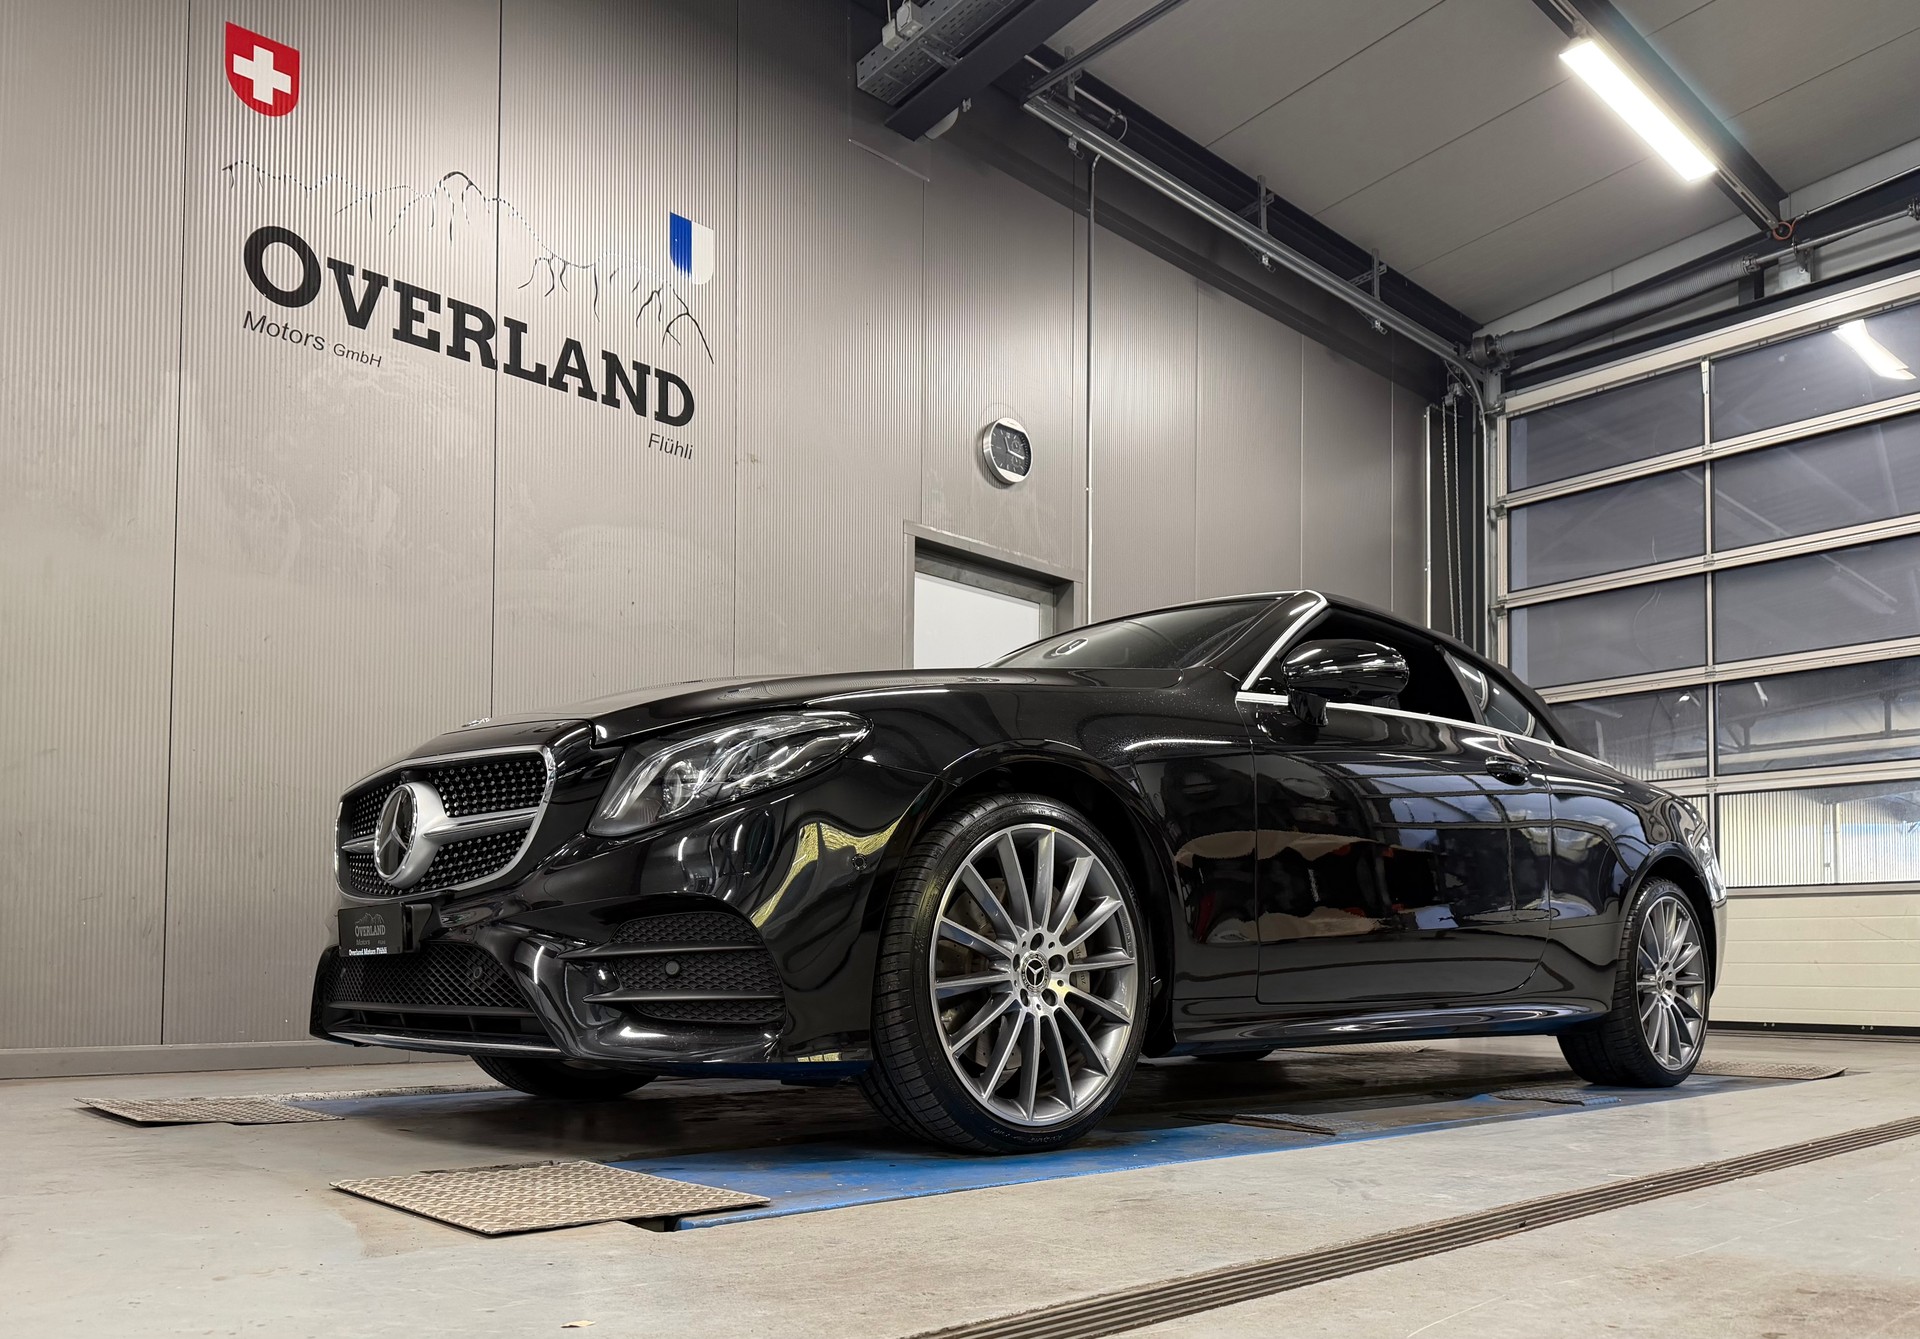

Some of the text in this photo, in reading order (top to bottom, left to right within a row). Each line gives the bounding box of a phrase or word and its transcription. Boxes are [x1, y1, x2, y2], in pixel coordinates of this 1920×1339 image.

[243, 225, 695, 427] OVERLAND
[243, 310, 382, 367] Motors GmbH
[648, 432, 693, 460] Flühli
[355, 925, 386, 937] OVERLAND
